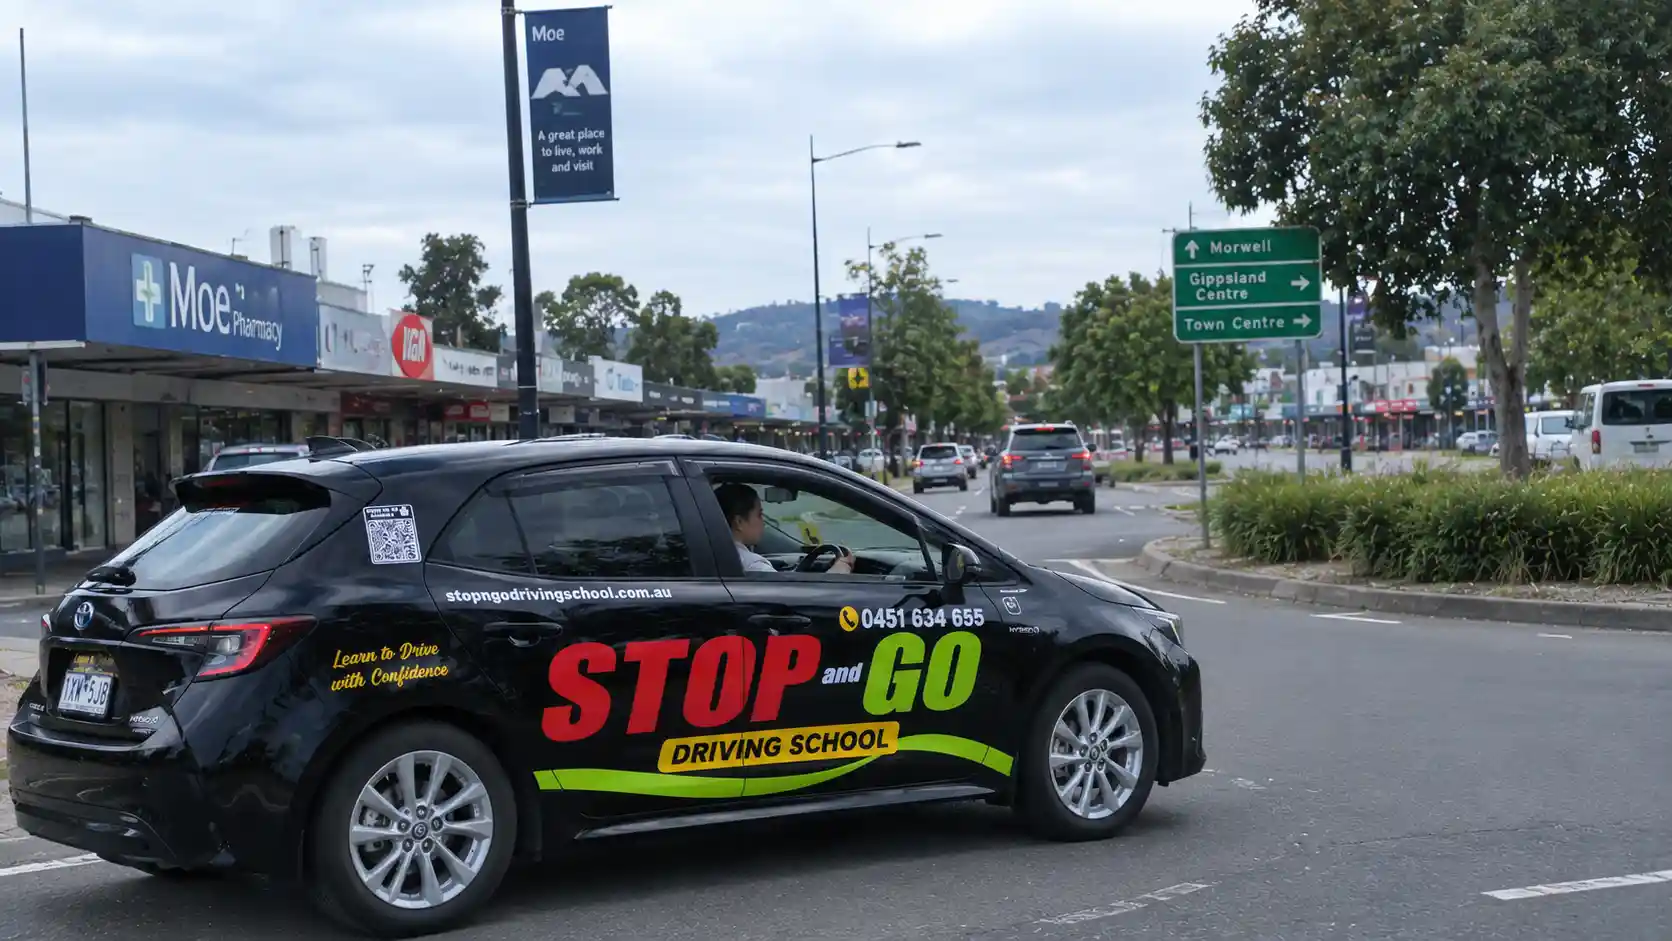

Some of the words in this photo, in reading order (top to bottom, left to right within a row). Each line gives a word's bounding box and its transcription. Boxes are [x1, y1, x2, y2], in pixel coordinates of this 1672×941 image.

[532, 25, 565, 42] Moe
[538, 130, 546, 141] A
[548, 129, 575, 143] great
[577, 128, 605, 142] place
[541, 146, 553, 157] to
[554, 145, 576, 158] live,
[578, 143, 603, 156] work
[551, 161, 571, 173] and
[573, 159, 594, 172] visit
[1209, 239, 1271, 254] Morwell
[1189, 271, 1267, 288] Gippsland
[1195, 288, 1248, 301] Centre
[169, 261, 231, 335] Moe
[233, 310, 283, 351] Pharmacy
[1184, 317, 1225, 331] Town
[1232, 316, 1285, 330] Centre
[445, 586, 673, 604] stopngodrivingschool.com.au
[861, 608, 904, 630] 0451
[911, 608, 947, 628] 634
[951, 607, 985, 627] 655
[333, 650, 377, 669] Learn
[381, 647, 395, 661] to
[400, 642, 440, 660] Drive
[331, 673, 366, 691] with
[371, 664, 448, 688] Confidence
[541, 635, 822, 743] STOP
[821, 663, 864, 685] and
[863, 631, 982, 716] GO
[671, 737, 782, 765] DRIVING
[789, 727, 890, 756] SCHOOL
